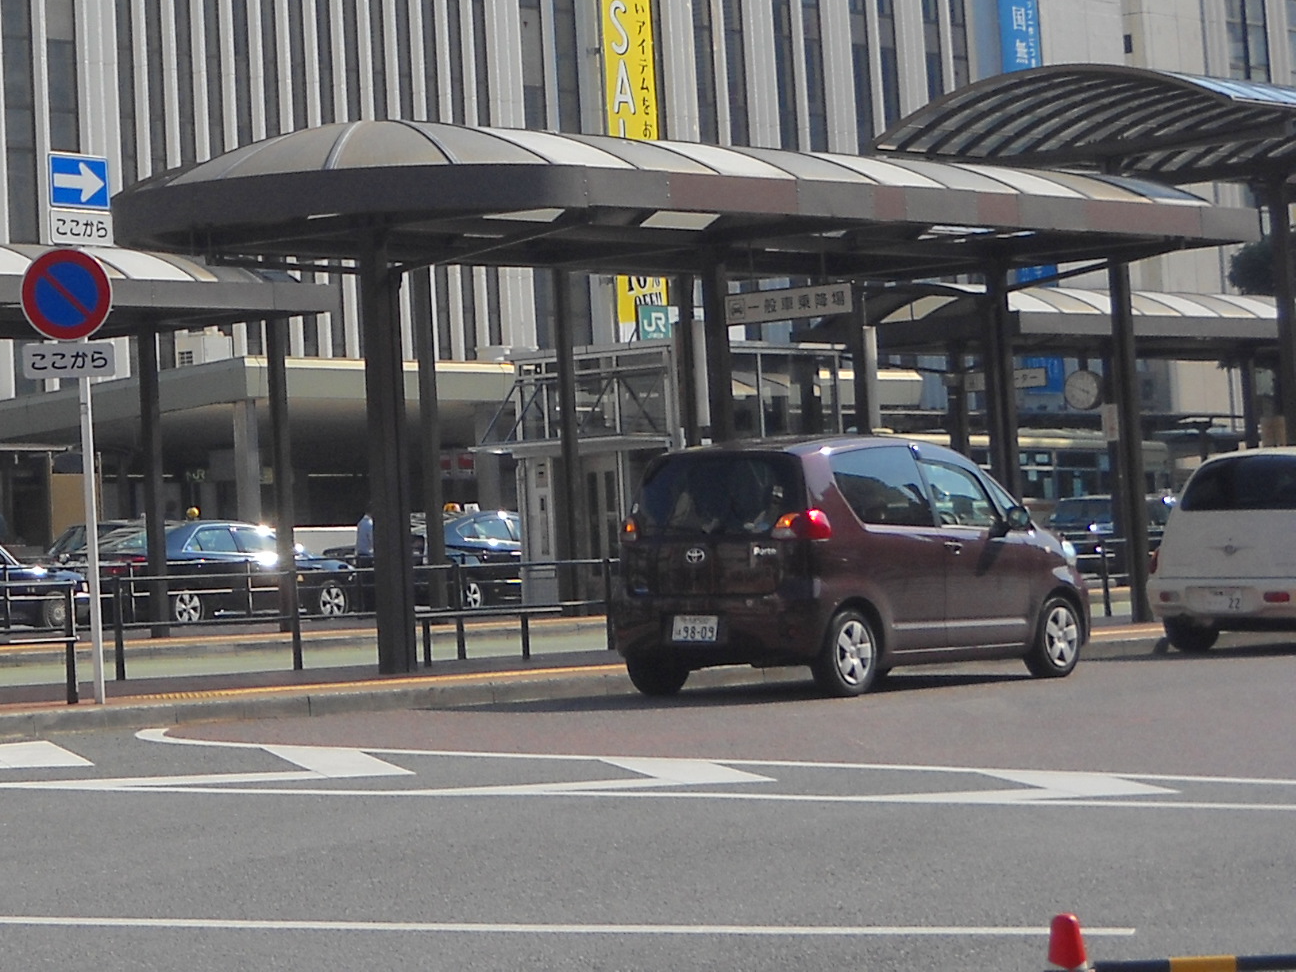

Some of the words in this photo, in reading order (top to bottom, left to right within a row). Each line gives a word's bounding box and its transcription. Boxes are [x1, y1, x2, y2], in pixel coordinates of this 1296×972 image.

[55, 218, 109, 238] ここから
[643, 311, 667, 333] JR
[31, 350, 108, 371] ここから
